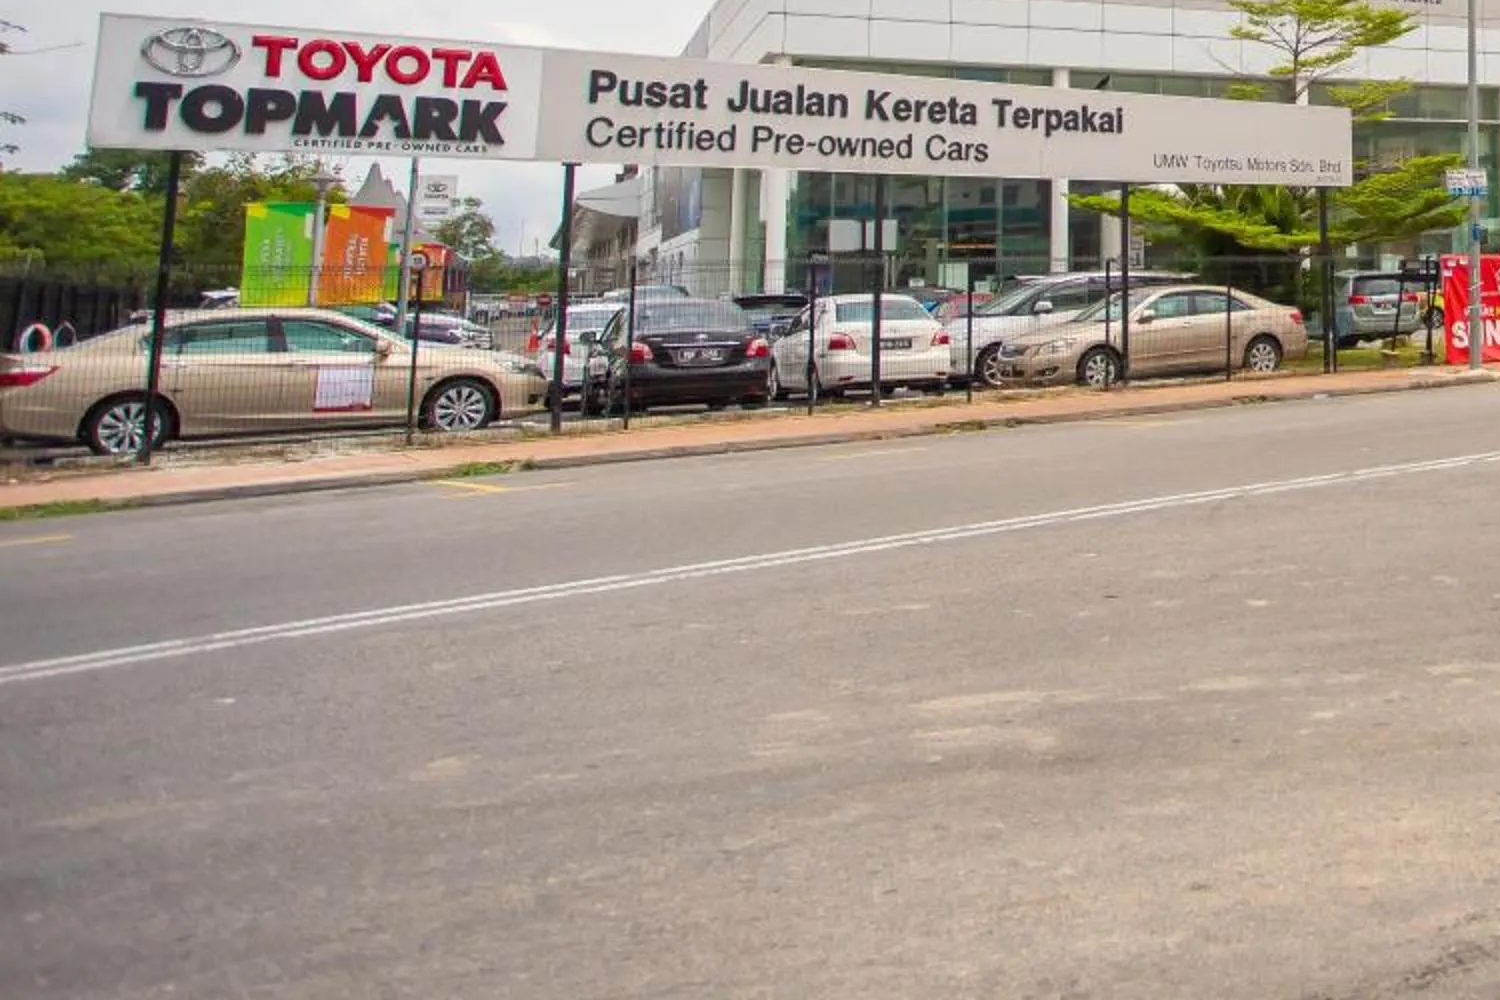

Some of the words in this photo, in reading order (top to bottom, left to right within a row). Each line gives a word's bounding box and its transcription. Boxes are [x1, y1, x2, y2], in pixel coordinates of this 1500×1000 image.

[252, 35, 508, 91] TOYOTA
[134, 80, 508, 145] TOPMARK
[589, 69, 708, 109] Pusat
[727, 79, 849, 118] Jualan
[865, 89, 977, 125] Kereta
[992, 99, 1123, 138] Terpakai
[294, 138, 361, 149] CERTIFIED
[456, 144, 489, 153] CARS
[586, 116, 736, 151] Certified
[752, 125, 913, 160] Pre-owned
[926, 134, 989, 162] Cars
[1153, 153, 1189, 169] UMW
[1193, 155, 1243, 172] Toyotsu
[1247, 157, 1286, 172] Motors
[1319, 159, 1342, 173] Bhd
